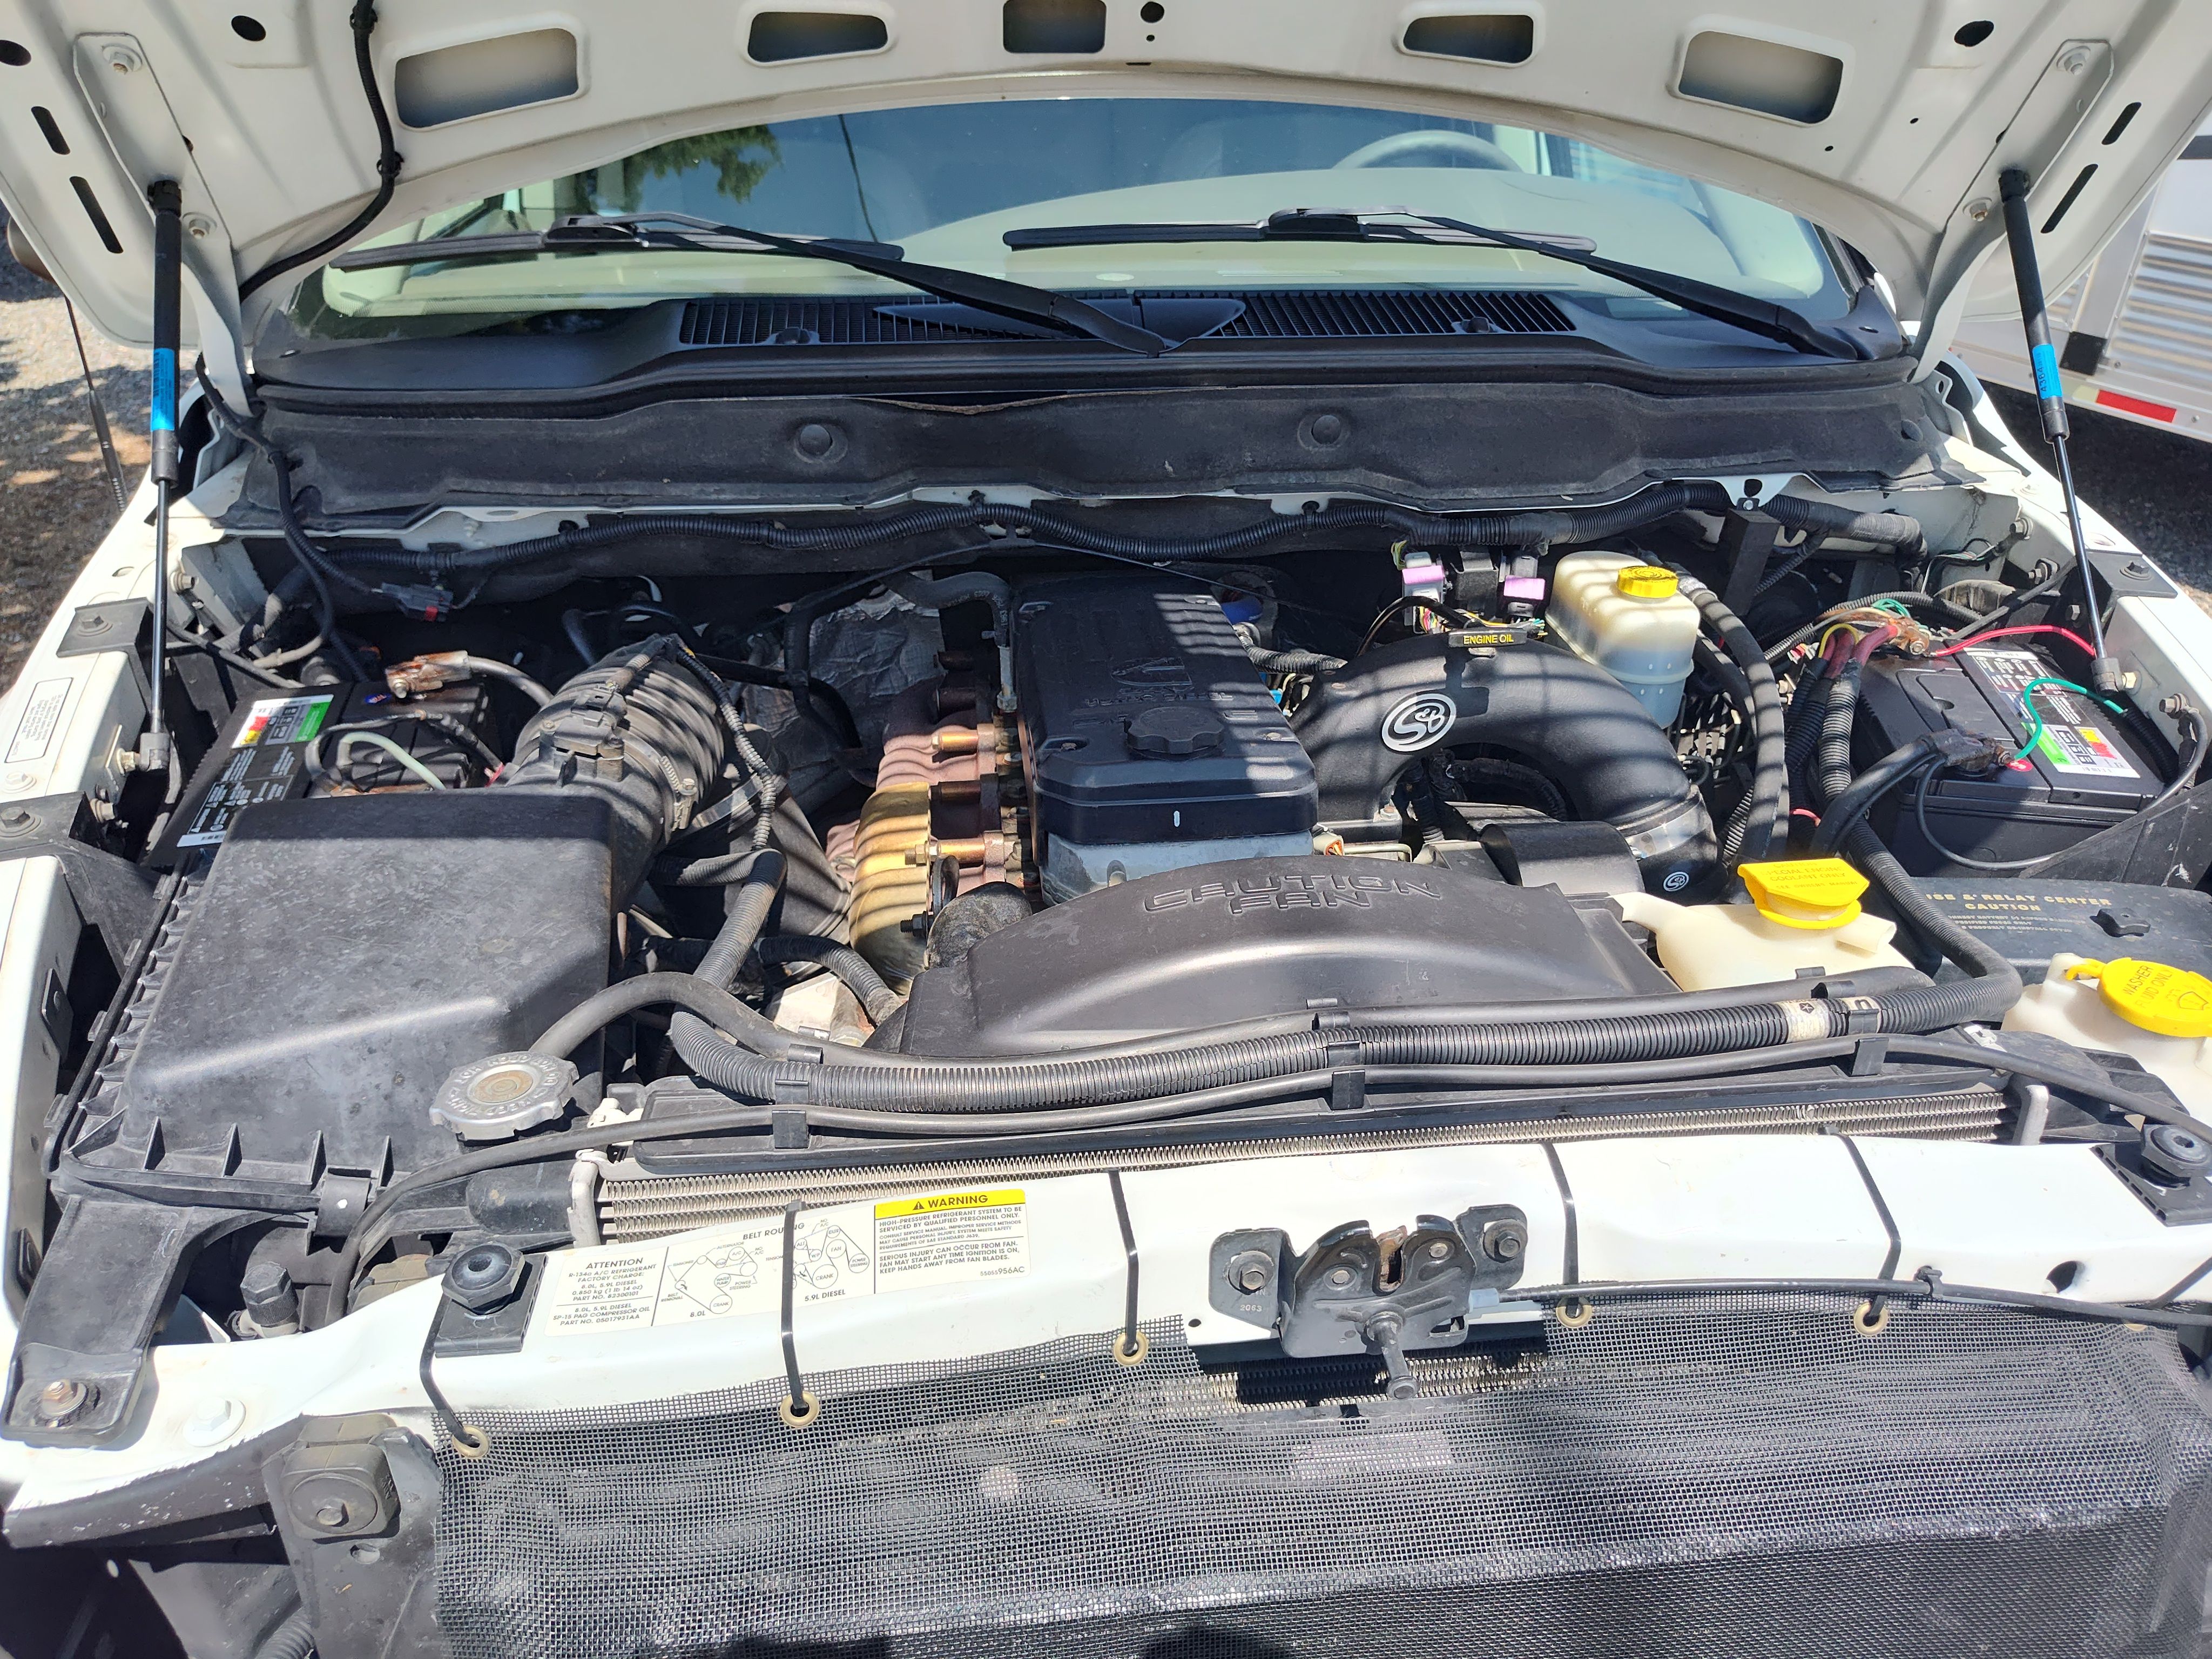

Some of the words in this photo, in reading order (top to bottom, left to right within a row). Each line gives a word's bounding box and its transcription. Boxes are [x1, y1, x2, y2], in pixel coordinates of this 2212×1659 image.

[1463, 635, 1498, 644] ENGINE
[1499, 634, 1514, 643] OIL
[1144, 874, 1441, 912] CAUTION
[1981, 894, 2036, 902] RELAY
[2044, 896, 2112, 905] CENTER
[1230, 891, 1371, 914] FAN
[2123, 965, 2154, 995] WASHER
[2135, 987, 2160, 1008] FLUID
[2152, 970, 2173, 987] ONLY
[928, 1195, 988, 1208] WARNING
[879, 1215, 930, 1227] HIGH-PRESSURE
[933, 1210, 976, 1219] REFRIGERANT
[879, 1223, 911, 1233] SERVICED
[924, 1217, 957, 1226] QUALIFIED
[743, 1231, 762, 1240] BELT
[765, 1223, 805, 1236] ROUG
[879, 1241, 916, 1250] REQUIREMENTS
[938, 1233, 965, 1241] STANDARD
[880, 1253, 907, 1262] SERIOUS
[910, 1249, 934, 1257] INJURY
[586, 1258, 643, 1269] ATTENTION
[611, 1264, 657, 1273] REFRIGERANT
[898, 1263, 922, 1272] HANDS
[980, 1266, 1025, 1276] 55055956AC
[805, 1292, 820, 1302] 5.9L
[822, 1289, 846, 1299] DIESEL
[590, 1309, 637, 1317] COMPRESSOR
[596, 1314, 640, 1323] 05017931AA
